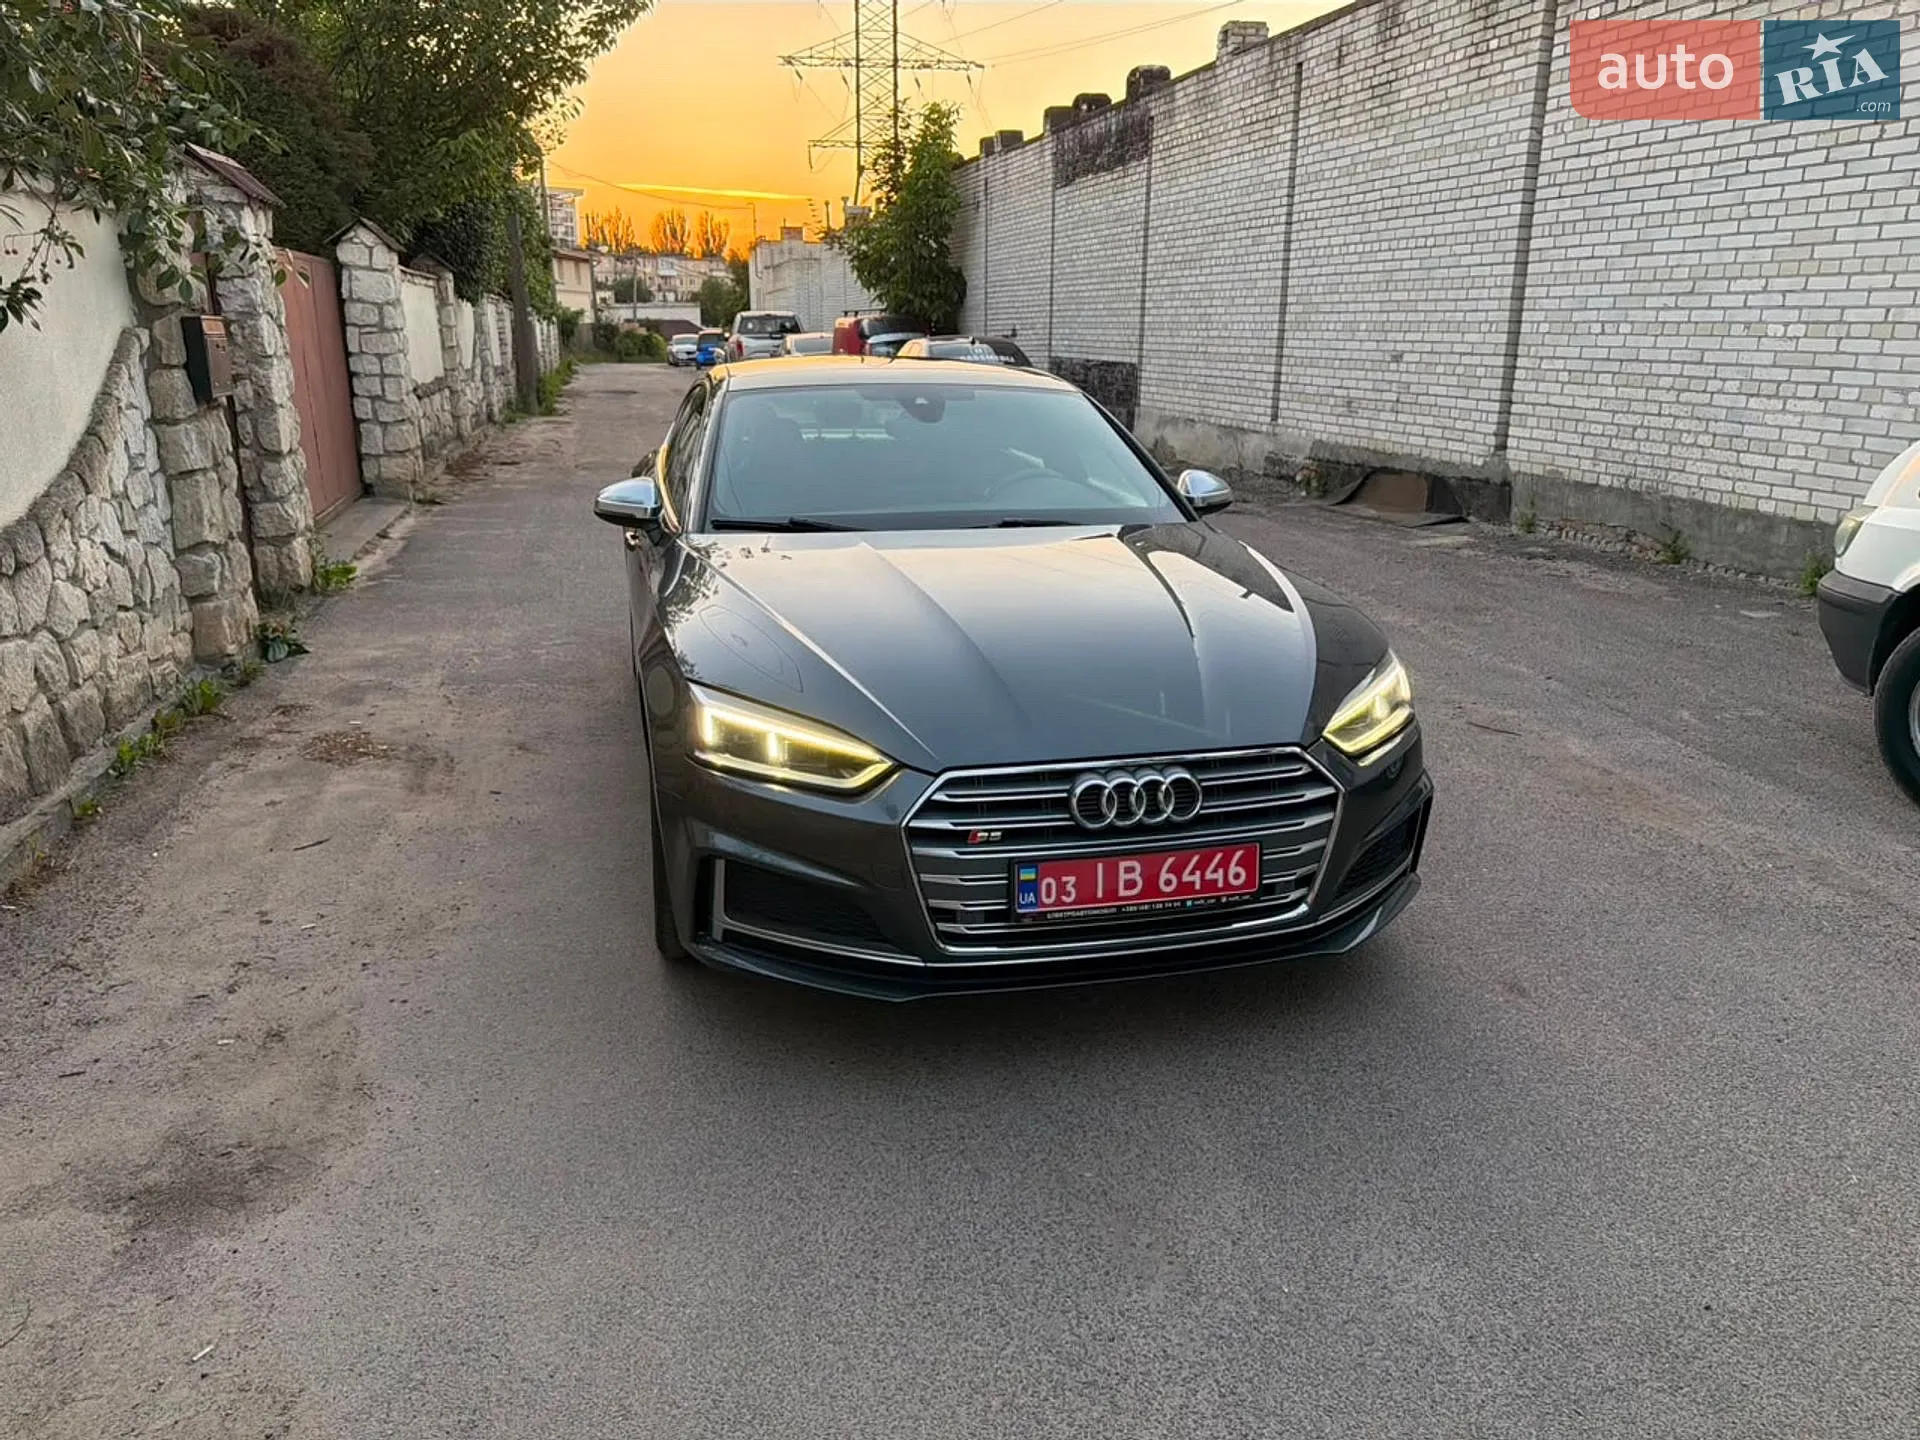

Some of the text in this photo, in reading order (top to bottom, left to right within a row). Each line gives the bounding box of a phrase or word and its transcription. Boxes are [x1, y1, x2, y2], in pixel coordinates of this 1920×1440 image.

[1040, 849, 1247, 905] 03 IB 6446
[1018, 891, 1036, 905] UA
